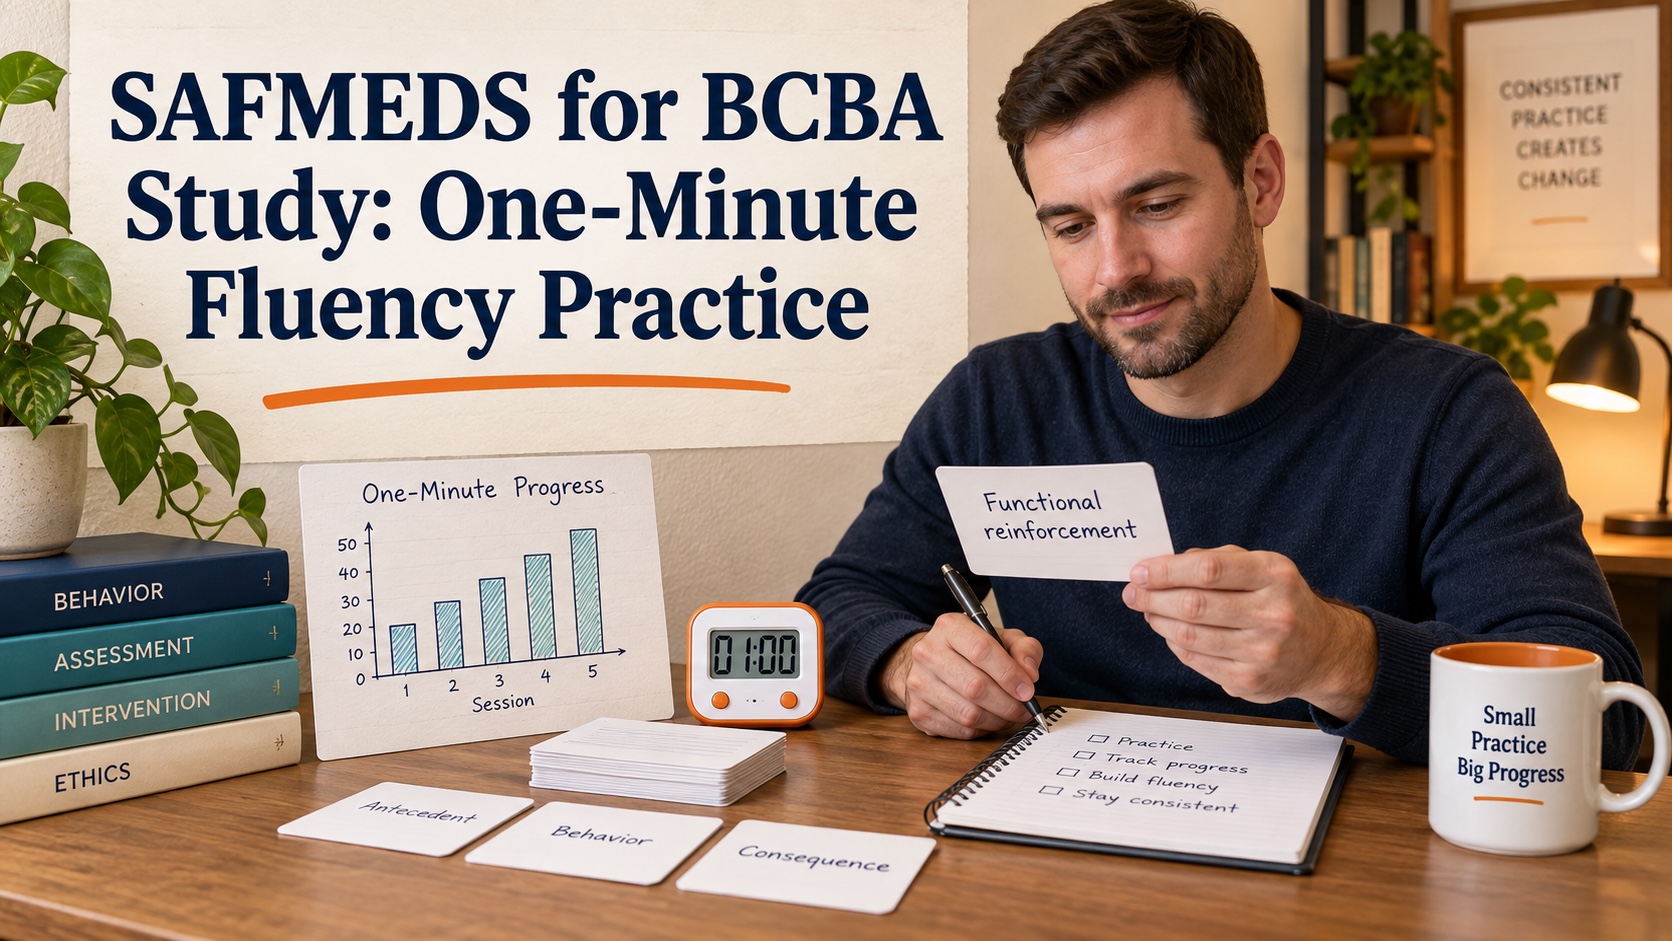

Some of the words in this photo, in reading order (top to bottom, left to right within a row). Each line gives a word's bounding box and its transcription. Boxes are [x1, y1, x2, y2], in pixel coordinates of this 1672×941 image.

[1499, 72, 1622, 101] CONSISTENT
[110, 70, 531, 143] SAFMEDS
[558, 68, 678, 142] for
[702, 71, 944, 142] BCBA
[1512, 105, 1608, 129] PRACTICE
[1516, 137, 1602, 160] CREATES
[1518, 168, 1601, 191] CHANGE
[126, 166, 390, 262] Study:
[420, 167, 918, 242] One-Minute
[185, 265, 514, 361] Fluency
[539, 266, 870, 342] Practice
[362, 478, 498, 504] One-Minute
[514, 476, 604, 506] Progress
[983, 489, 1102, 512] Functional
[984, 519, 1137, 540] reinforcement
[337, 538, 357, 551] 50
[338, 567, 359, 579] 40
[54, 582, 164, 611] BEHAVIOR
[341, 595, 360, 608] 30
[342, 622, 362, 636] 20
[54, 636, 194, 672] ASSESSMENT
[348, 648, 363, 661] 10
[714, 635, 796, 675] 01:00
[356, 673, 366, 686] 0
[403, 684, 409, 697] 1
[449, 679, 459, 692] 2
[495, 674, 505, 688] 3
[541, 669, 551, 683] 4
[588, 664, 598, 678] 5
[55, 690, 211, 731] INTERVENTION
[472, 695, 535, 712] Session
[1484, 705, 1536, 726] Small
[1117, 736, 1194, 751] Practice
[1472, 731, 1547, 754] Practice
[1106, 753, 1157, 766] Track
[1166, 761, 1248, 774] progress
[1458, 757, 1484, 783] Big
[1488, 762, 1564, 788] Progress
[55, 762, 131, 793] ETHICS
[1089, 770, 1139, 784] Build
[1147, 776, 1219, 794] fluency
[358, 800, 478, 825] Antecedent
[1072, 789, 1119, 806] Stay
[1130, 798, 1240, 814] consistent
[551, 825, 654, 848] Behavior
[737, 844, 890, 874] Consequence
